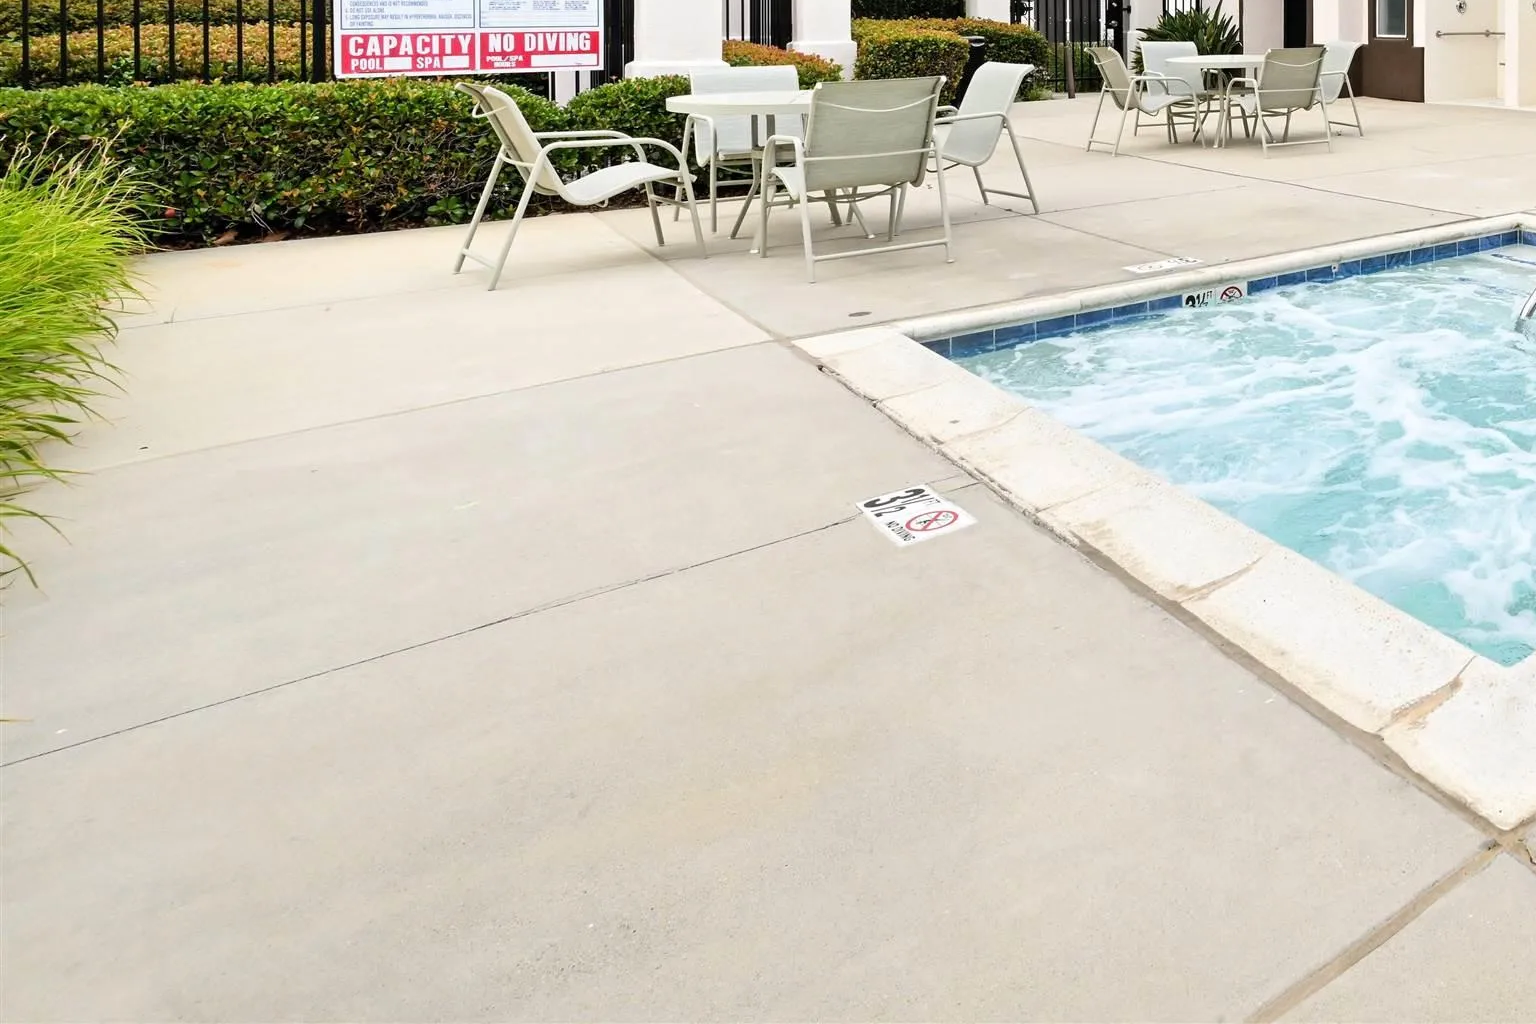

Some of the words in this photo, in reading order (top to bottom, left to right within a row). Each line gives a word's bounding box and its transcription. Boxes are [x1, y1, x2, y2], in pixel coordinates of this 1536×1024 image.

[349, 35, 472, 57] CAPACITY
[488, 33, 515, 53] NO
[524, 32, 591, 52] DIVING
[351, 58, 383, 71] POOL
[416, 56, 441, 69] SPA
[891, 526, 916, 541] DIVING
